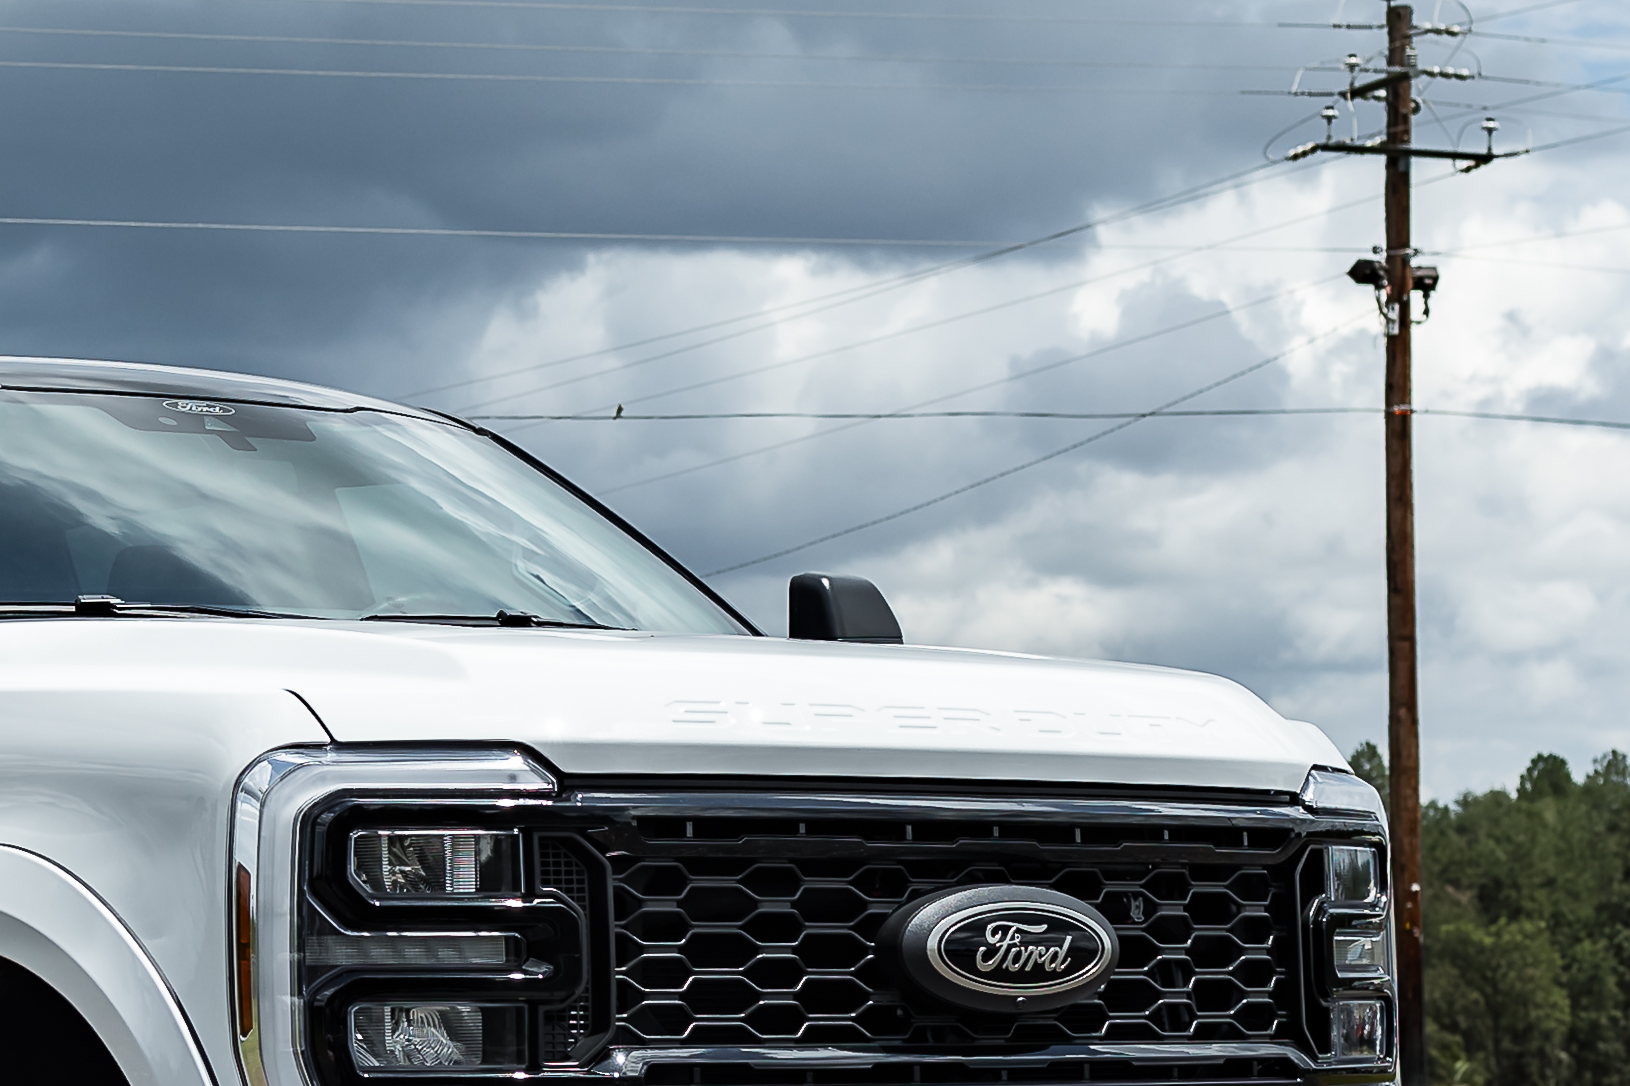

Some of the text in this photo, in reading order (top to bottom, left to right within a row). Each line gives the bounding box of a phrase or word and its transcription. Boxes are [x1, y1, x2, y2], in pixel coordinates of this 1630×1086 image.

[664, 698, 1218, 744] SUPER DUTY
[976, 921, 1073, 972] Ford
